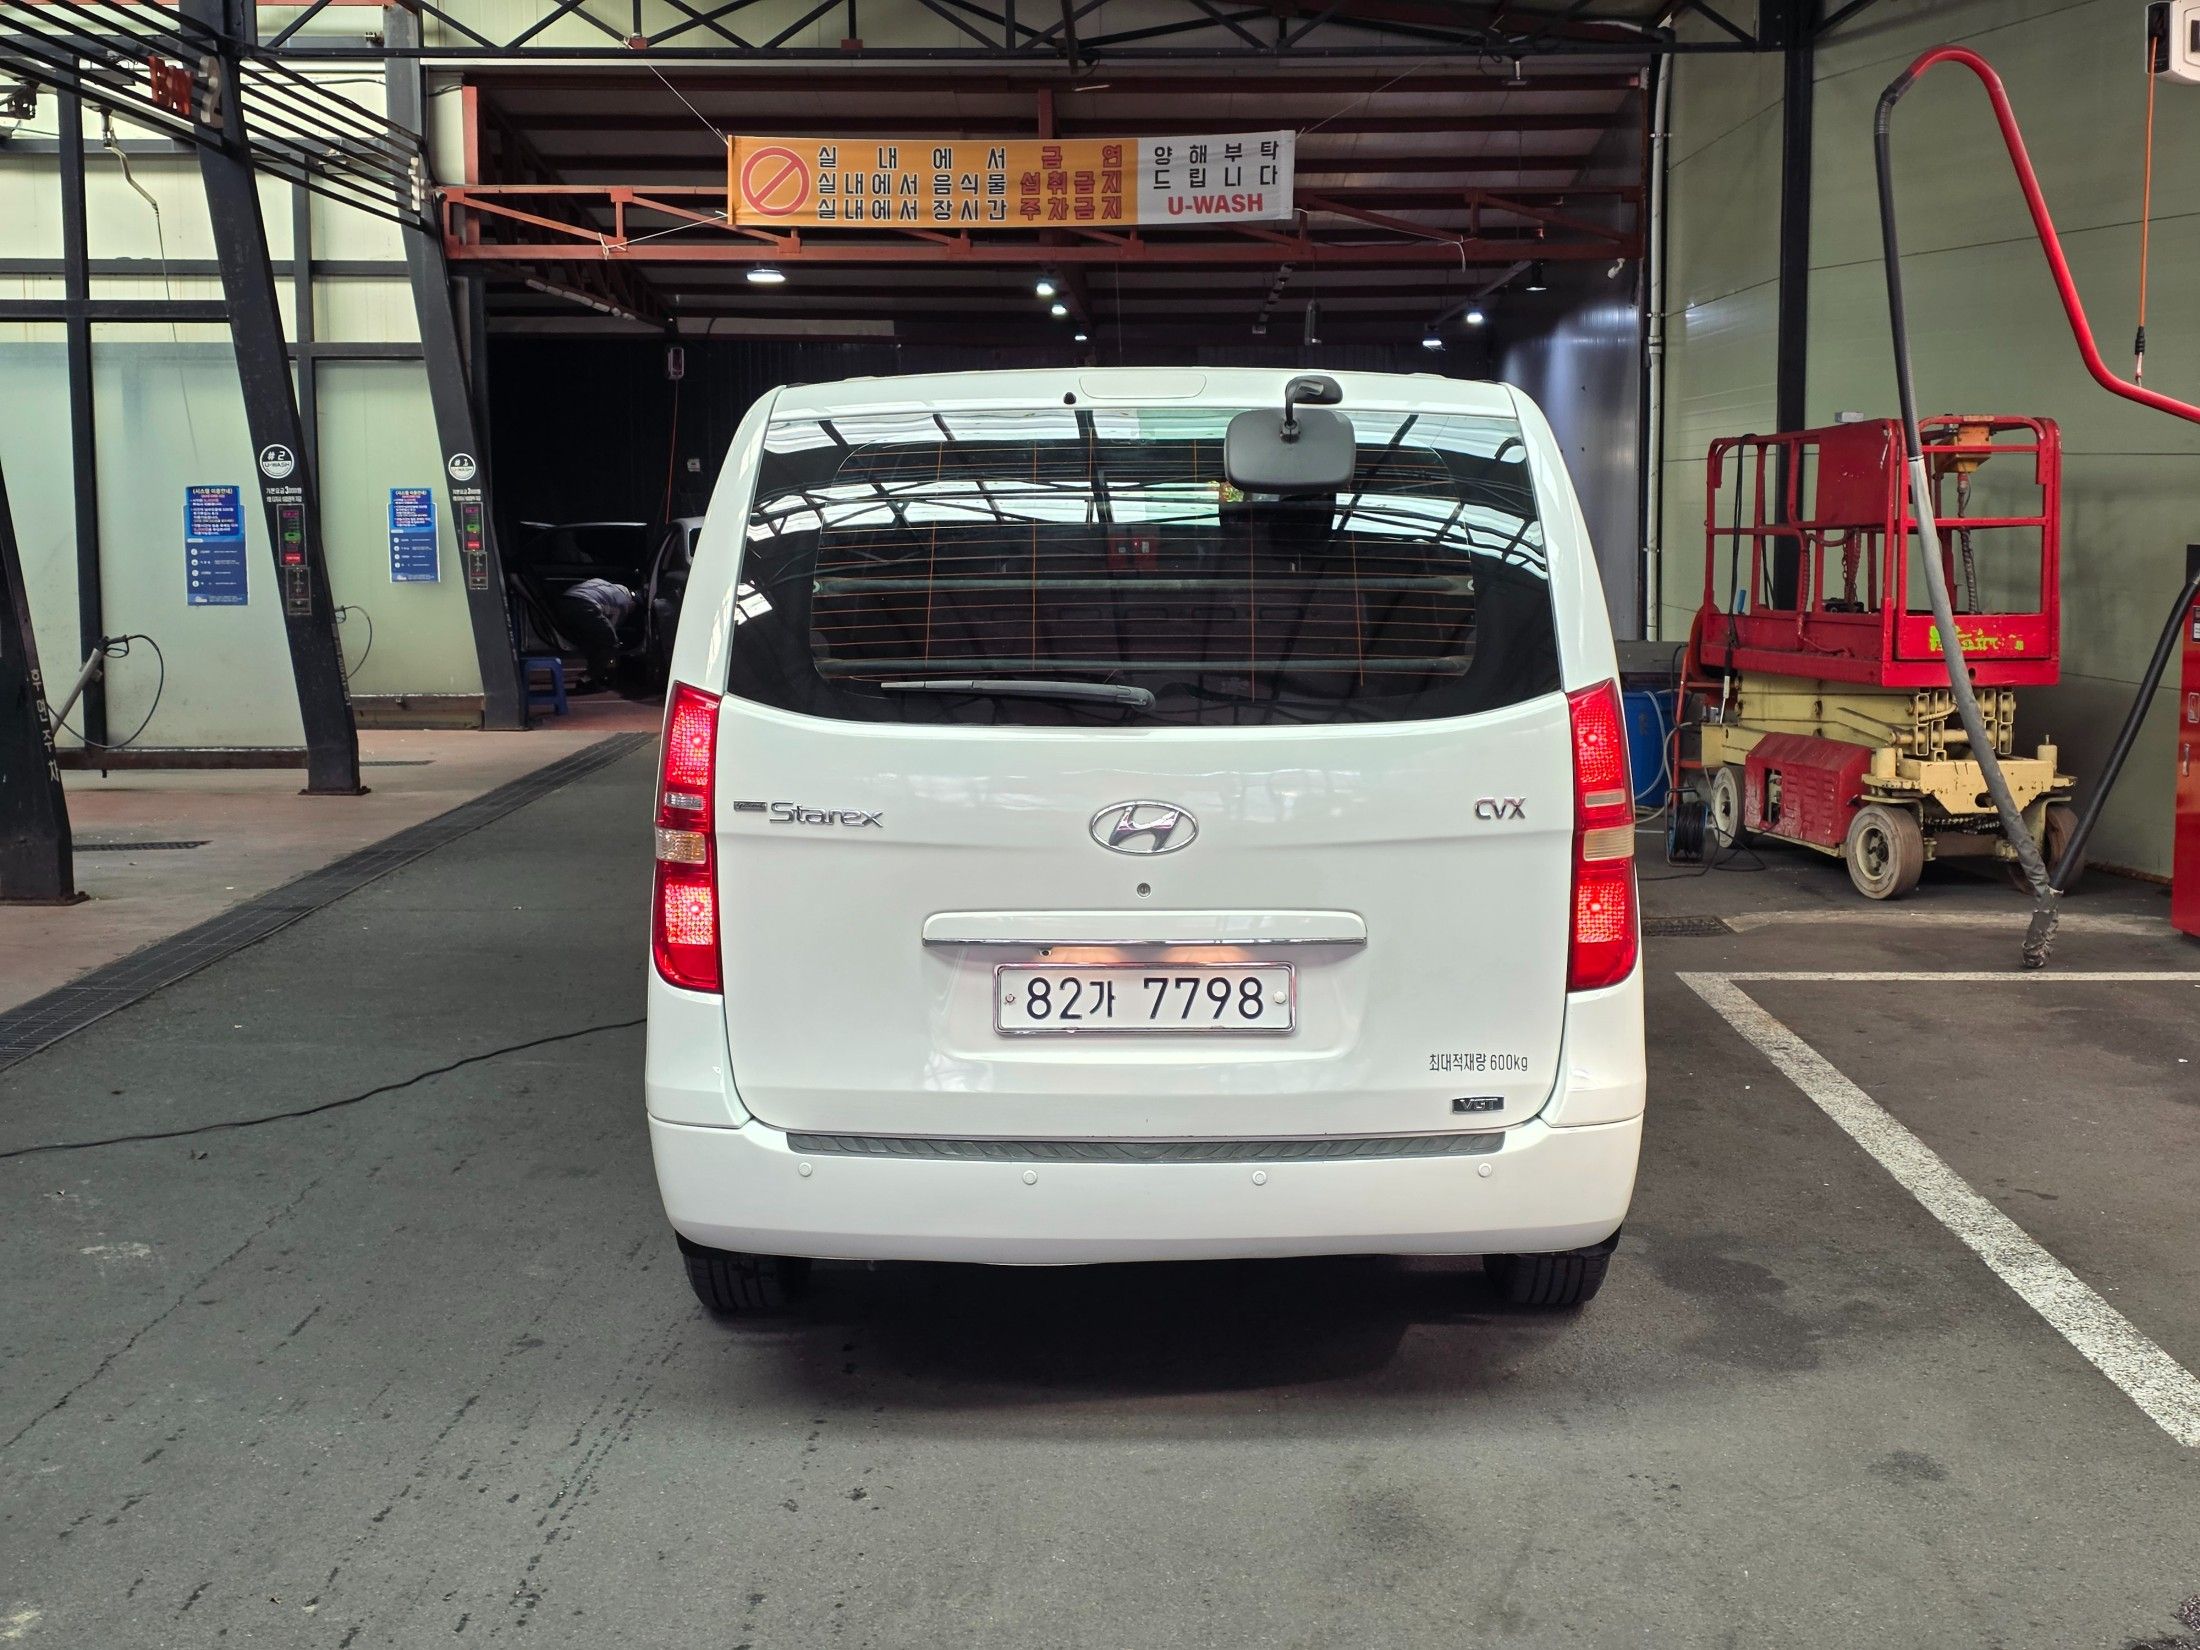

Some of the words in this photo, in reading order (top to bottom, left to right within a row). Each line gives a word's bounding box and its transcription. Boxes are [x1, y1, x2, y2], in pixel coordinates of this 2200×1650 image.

[818, 172, 918, 195] 실내에서
[932, 173, 1006, 195] 음식물
[1020, 171, 1122, 195] 섭취금지
[818, 198, 918, 221] 실내에서
[932, 199, 1006, 221] 장시간
[1020, 196, 1122, 221] 주차금지
[1168, 193, 1264, 216] U-WASH
[769, 801, 884, 828] Starex
[1474, 797, 1526, 820] CVX
[1026, 976, 1117, 1020] 82가
[1143, 976, 1264, 1020] 7798
[1429, 1053, 1487, 1072] 최대적재량
[1490, 1054, 1528, 1072] 600kg
